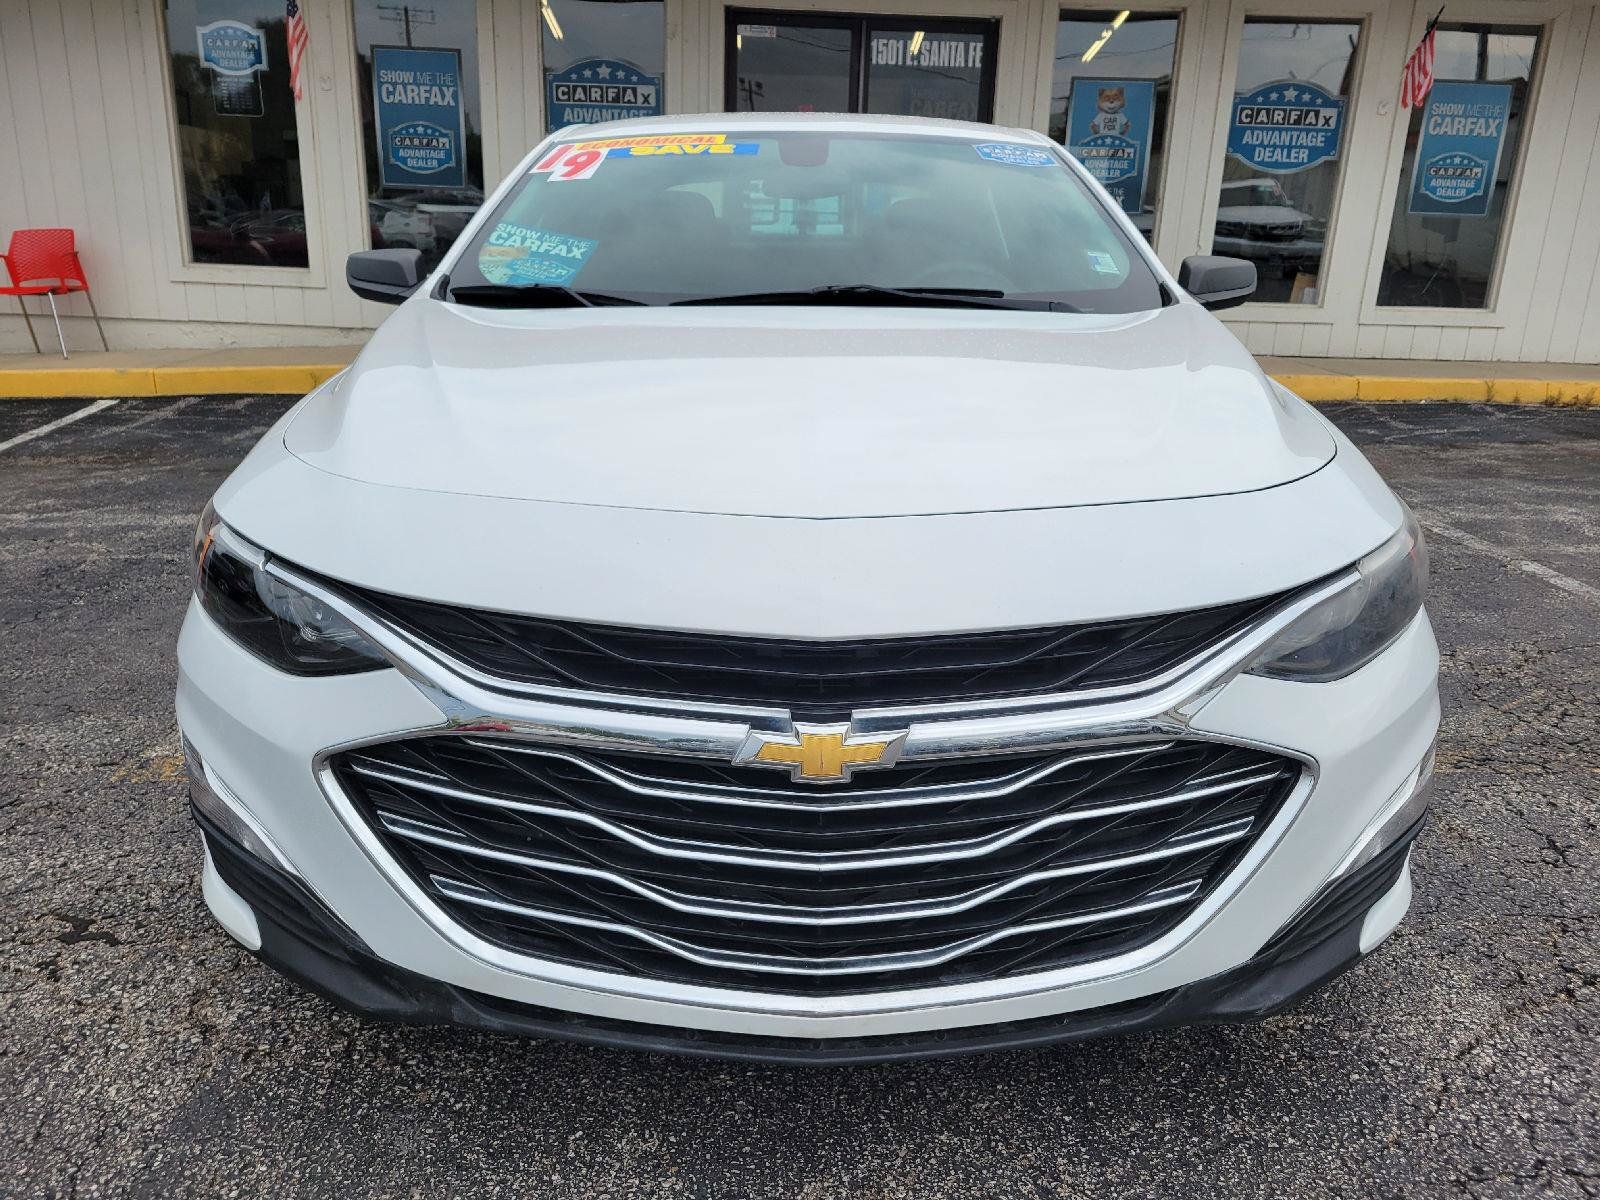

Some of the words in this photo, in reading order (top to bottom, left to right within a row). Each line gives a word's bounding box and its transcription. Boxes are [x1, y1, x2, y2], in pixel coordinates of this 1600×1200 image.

[206, 38, 258, 49] CARFAX
[871, 39, 904, 65] 1501
[921, 40, 965, 67] SANTA
[968, 42, 984, 68] FE
[380, 70, 414, 84] SHOW
[417, 72, 432, 84] ME
[436, 72, 455, 85] THE
[381, 83, 456, 107] CARFAX
[557, 86, 652, 105] CARFAX
[1432, 103, 1465, 115] SHOW
[1466, 104, 1480, 116] ME
[1481, 105, 1503, 117] THE
[1240, 109, 1334, 128] CARFAX
[1428, 116, 1501, 137] CARFAX
[394, 137, 449, 148] CARFAX
[577, 136, 717, 150] ECONOMICAL
[1242, 130, 1326, 147] ADVANTAGE
[399, 148, 446, 159] ADVANTAGE
[630, 143, 735, 156] SAVE
[1082, 148, 1133, 158] CARFAX
[1253, 147, 1309, 163] DEALER
[407, 158, 438, 168] DEALER
[536, 144, 602, 178] 19
[1430, 167, 1481, 178] CARFAX
[1430, 179, 1476, 187] ADVANTAGE
[1436, 187, 1466, 197] DEALER
[496, 223, 540, 240] SHOW
[543, 234, 563, 245] ME
[568, 239, 592, 249] THE
[489, 231, 586, 259] CARFAX
